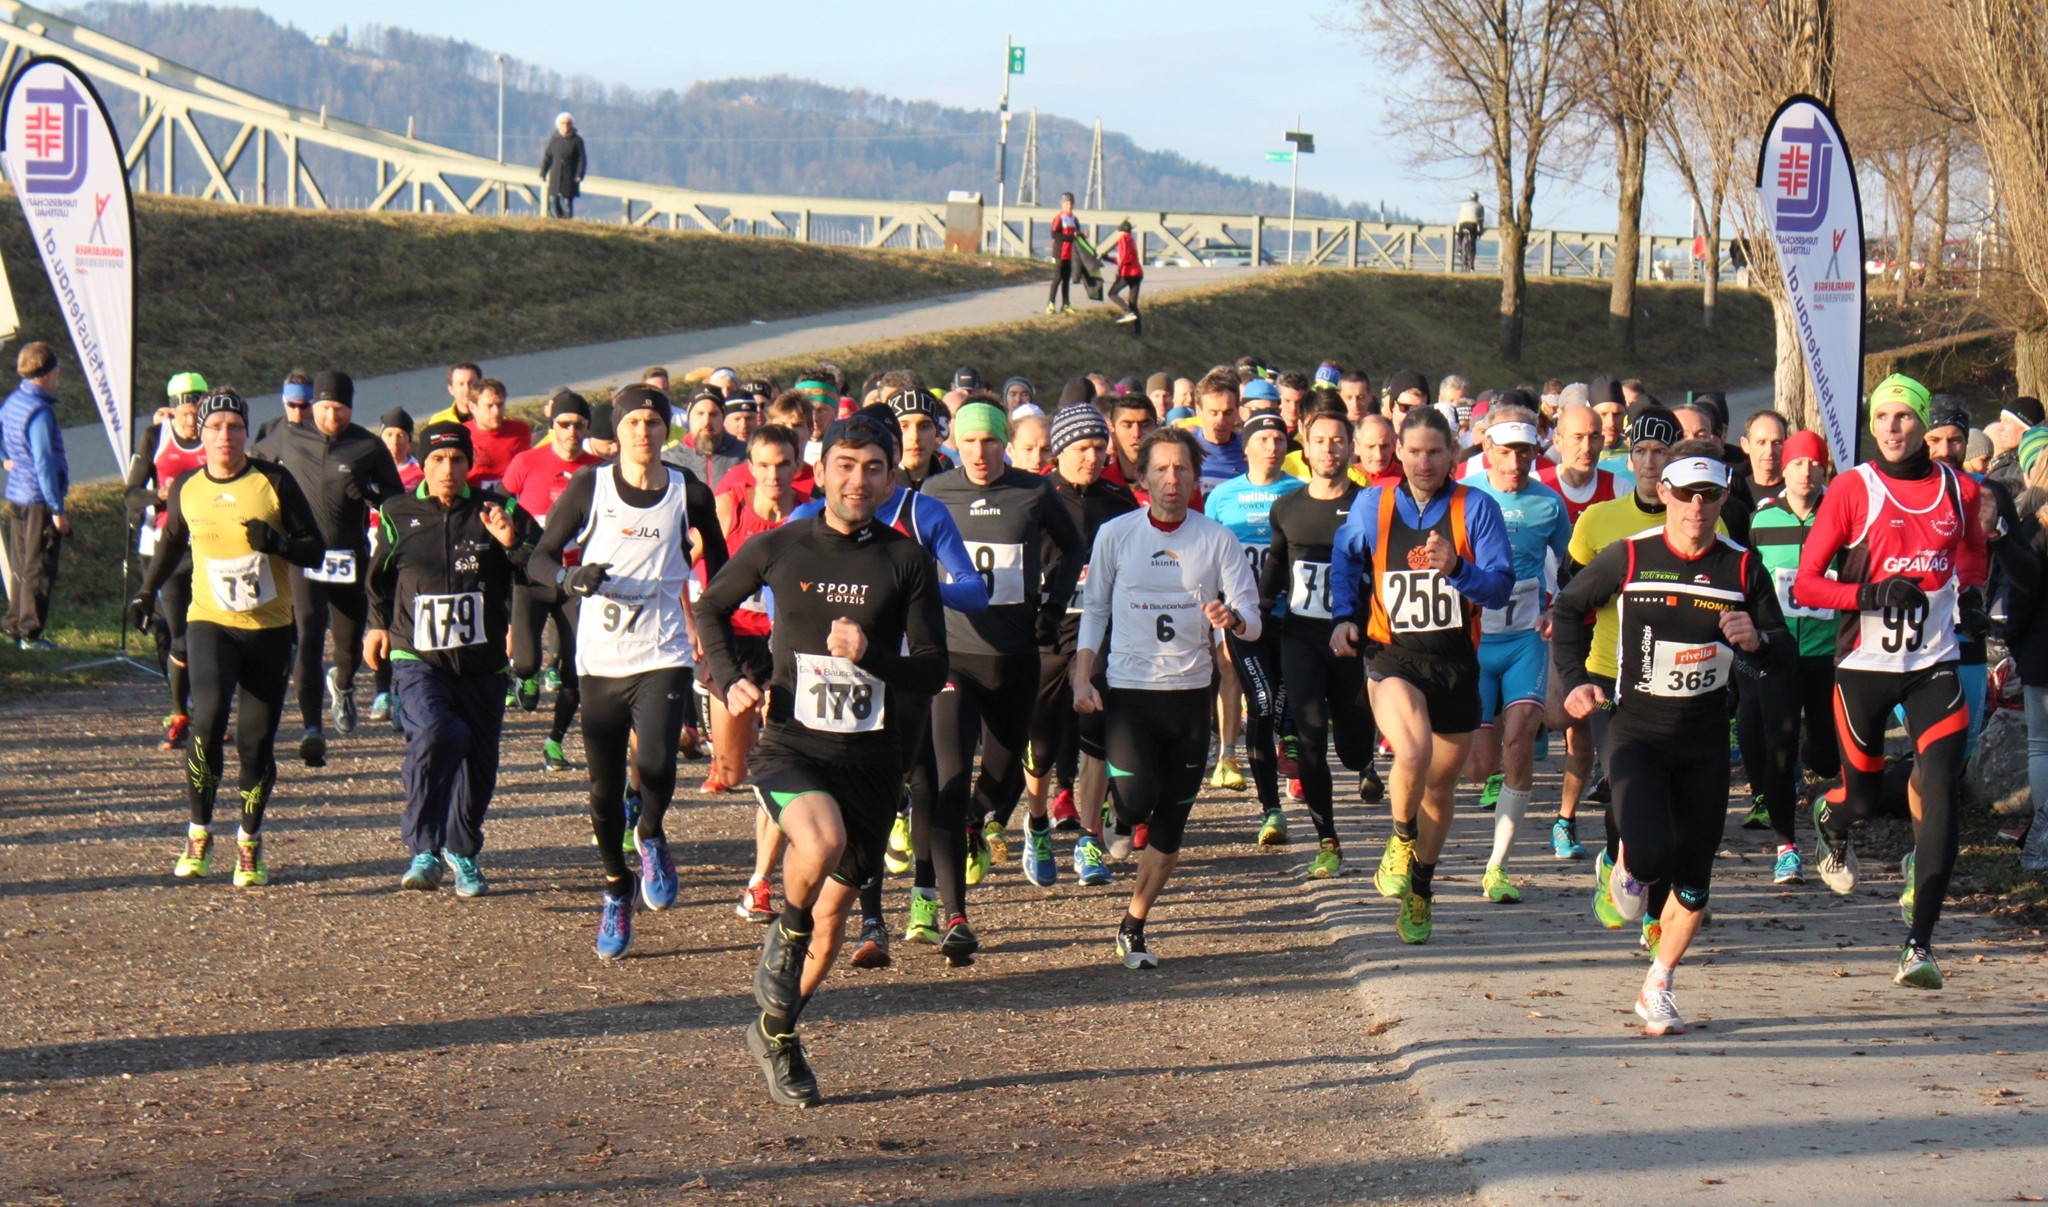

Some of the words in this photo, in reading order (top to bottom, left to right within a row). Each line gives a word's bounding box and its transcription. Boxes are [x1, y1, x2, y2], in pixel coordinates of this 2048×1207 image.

[969, 508, 1001, 516] skinfit
[637, 526, 660, 538] JLA
[222, 572, 261, 601] 73
[816, 582, 869, 596] SPORT
[1149, 602, 1198, 610] Bausparkasse
[1389, 572, 1452, 629] 256
[1693, 599, 1735, 611] THOMAS
[422, 595, 476, 648] 179
[603, 603, 644, 634] 97
[1156, 613, 1175, 643] 6
[1680, 649, 1713, 663] rivella
[1244, 656, 1269, 717] hellblau.com
[1667, 668, 1717, 691] 365
[809, 683, 873, 720] 178
